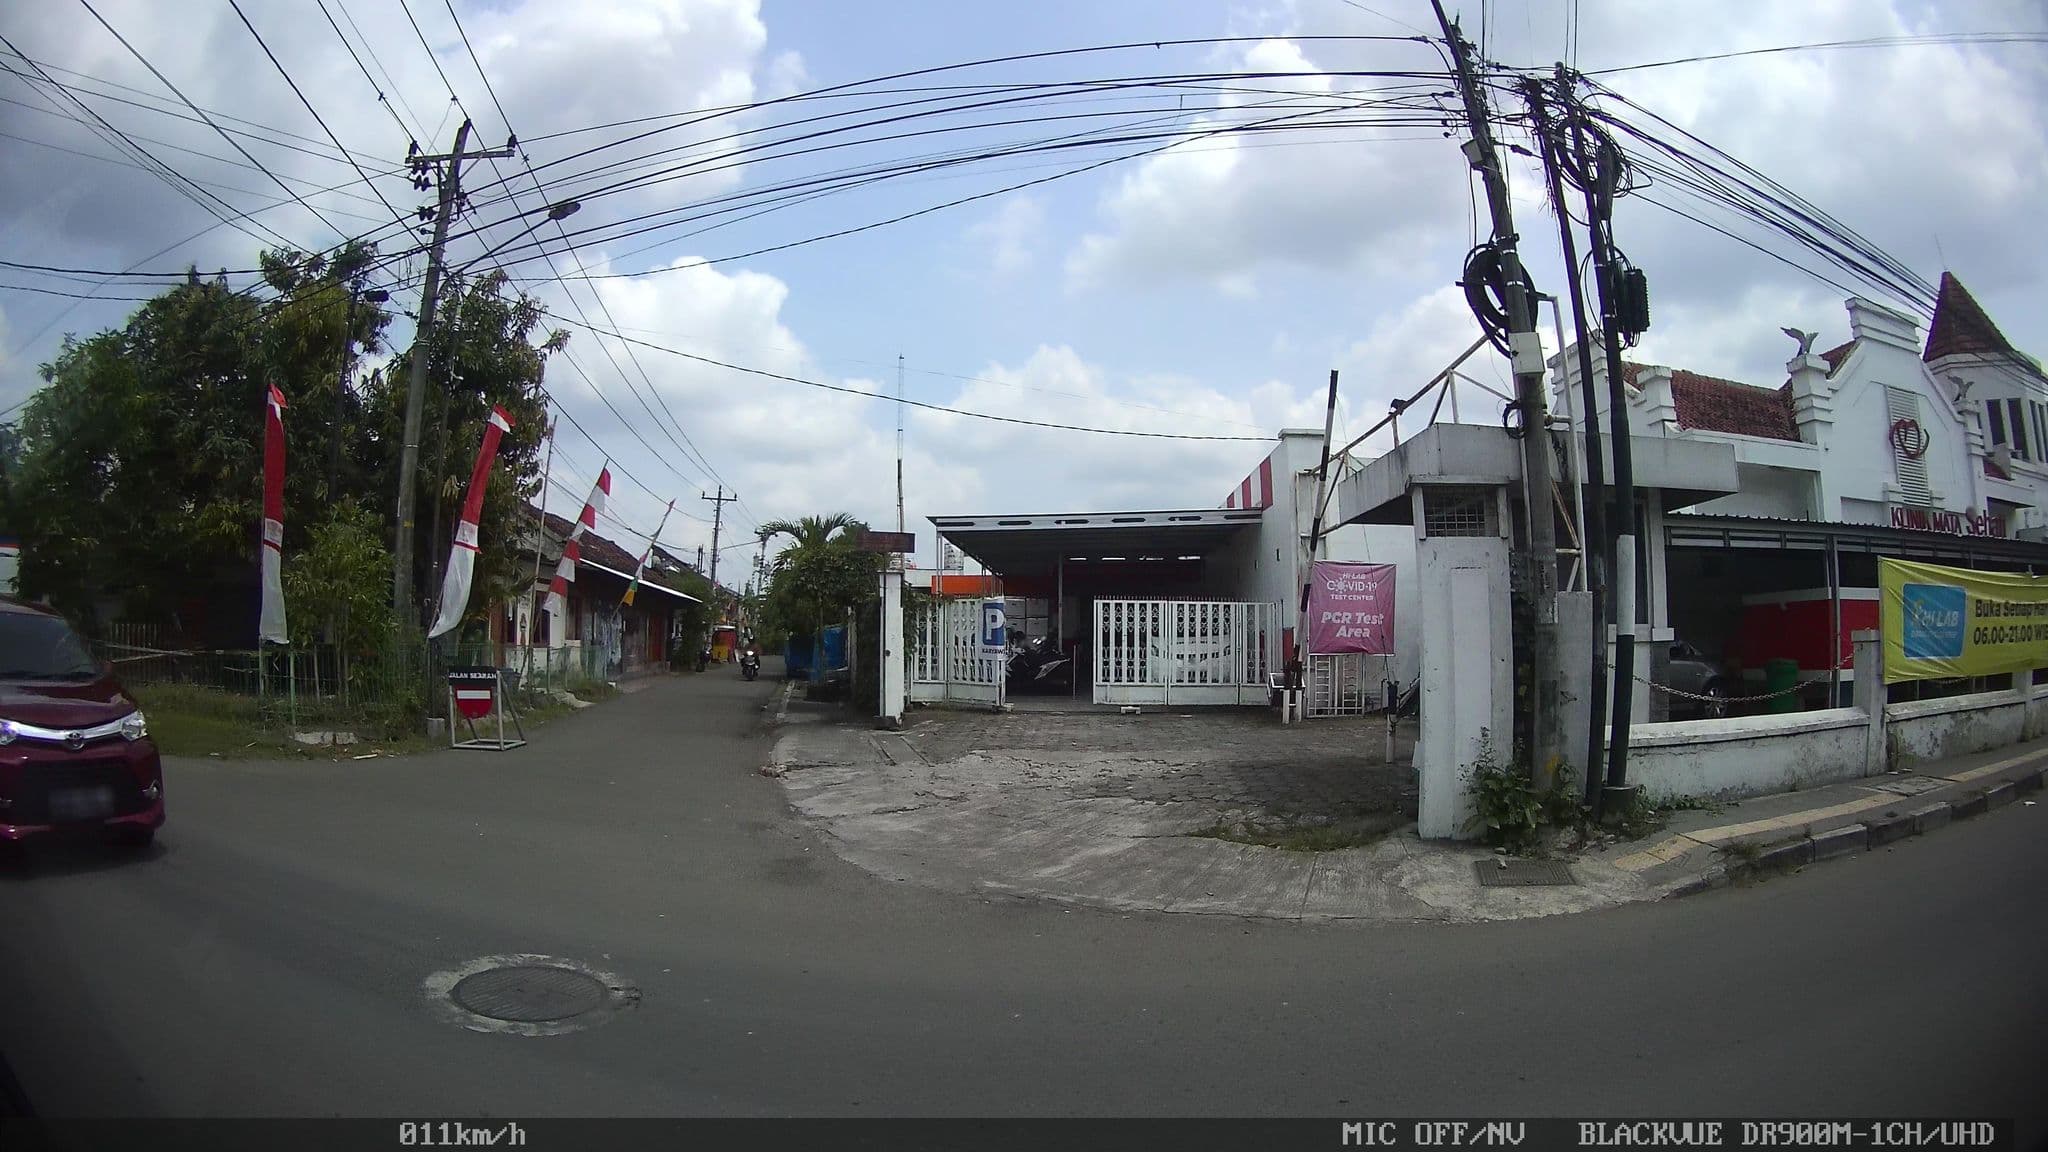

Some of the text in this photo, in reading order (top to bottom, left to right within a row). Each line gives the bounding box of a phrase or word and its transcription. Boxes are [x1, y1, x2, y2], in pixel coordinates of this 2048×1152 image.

[1932, 511, 1962, 535] MATA
[1321, 611, 1384, 625] PCR Test
[1975, 599, 2001, 618] Buka
[985, 608, 1005, 640] P
[1335, 625, 1370, 638] Area
